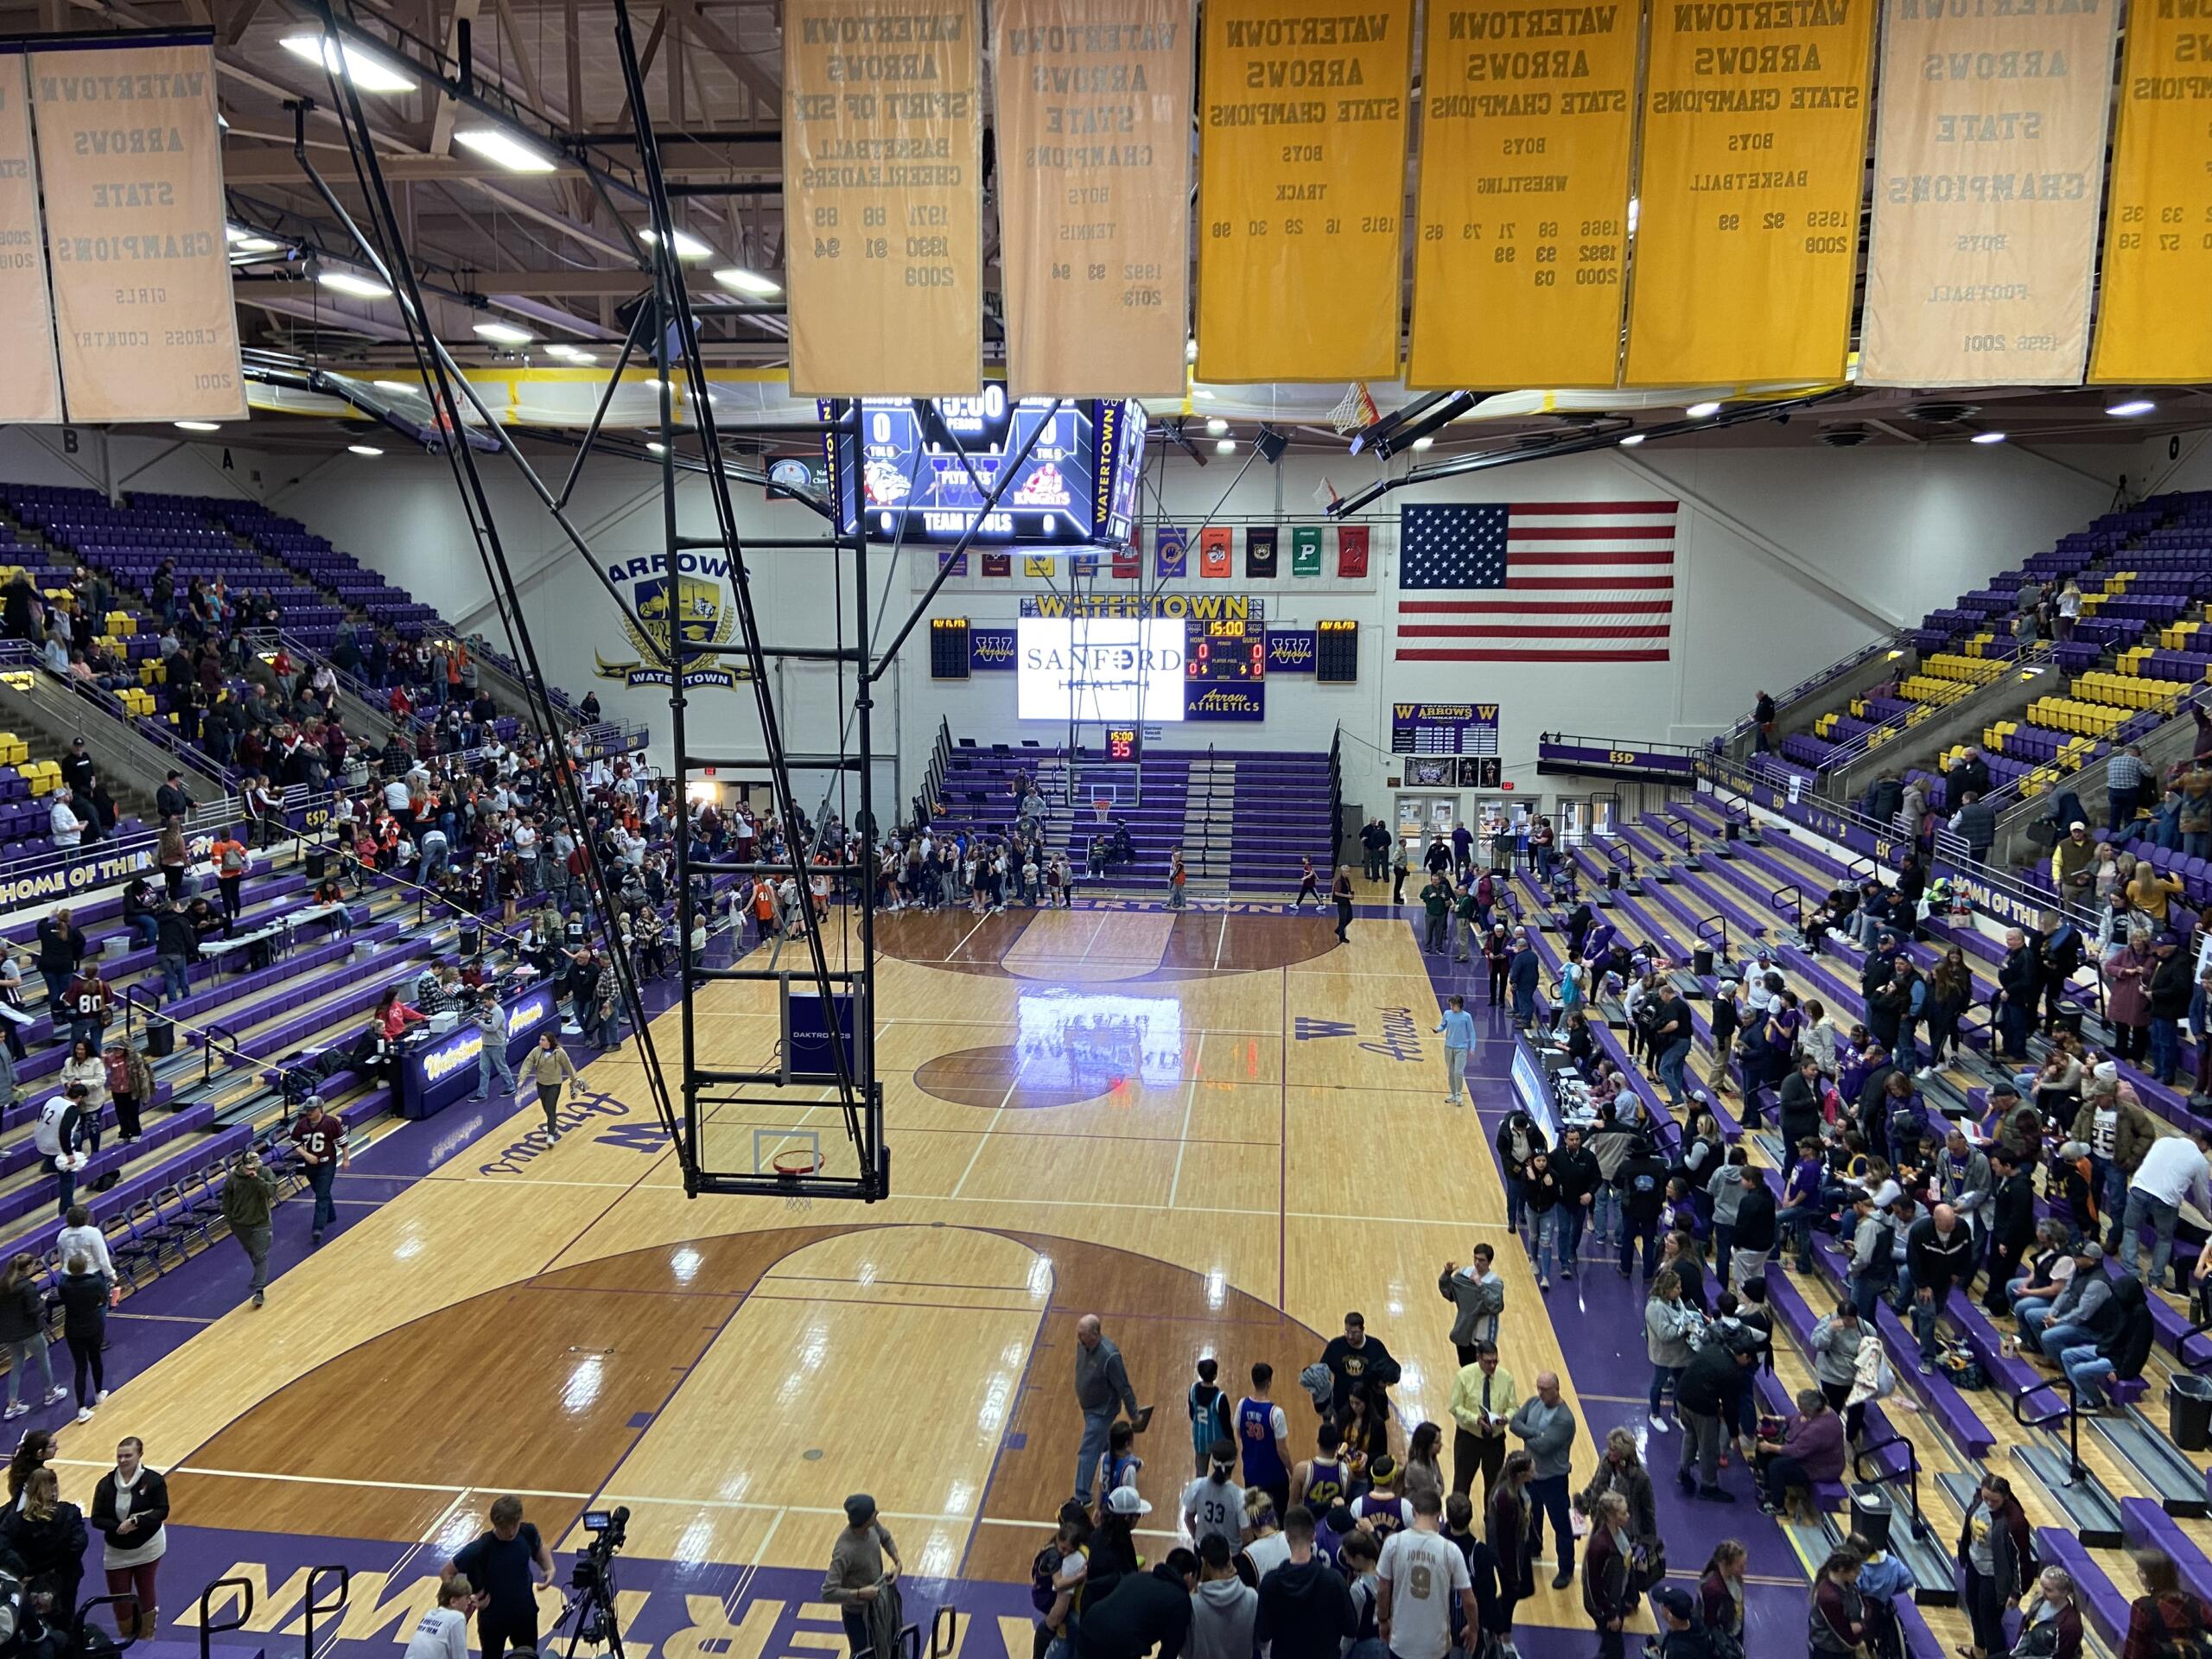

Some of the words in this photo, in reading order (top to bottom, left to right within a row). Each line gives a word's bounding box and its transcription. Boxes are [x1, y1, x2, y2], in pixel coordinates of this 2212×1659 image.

[873, 412, 891, 443] 0
[63, 429, 79, 454] B
[222, 448, 234, 470] A
[1096, 410, 1115, 523] WATERTOWN
[1014, 492, 1071, 505] KNIGHTS
[880, 512, 892, 529] 0
[923, 513, 964, 531] TEAM
[1043, 514, 1054, 531] 0
[1298, 544, 1315, 560] P
[1036, 594, 1249, 620] WATERTOWN
[1210, 620, 1243, 635] 15:00
[973, 645, 1014, 657] Arrows
[976, 637, 1012, 662] W
[1198, 644, 1207, 658] 0
[1253, 644, 1262, 658] 0
[1268, 646, 1313, 658] Arrows
[1272, 639, 1310, 664] W
[1027, 648, 1181, 671] SANFORD
[1189, 663, 1197, 674] 0
[1254, 663, 1262, 674] 0
[632, 672, 728, 685] WATETOWN
[1058, 680, 1150, 690] HEALTH
[1200, 688, 1248, 702] Arrow
[1189, 702, 1259, 711] ATHLETICS
[1395, 705, 1414, 719] W
[1418, 708, 1472, 718] ARROWS
[1477, 706, 1497, 720] W
[1110, 732, 1133, 741] 15:00
[1112, 741, 1130, 757] 35
[1610, 751, 1635, 764] ESD
[1731, 775, 1753, 795] ARROWS
[1773, 794, 1784, 809] ESD
[306, 810, 328, 825] ESD
[0, 870, 66, 905] HOME
[69, 864, 97, 887] OF
[759, 892, 768, 901] 41
[1953, 874, 1990, 908] HOME
[1992, 893, 2010, 916] OF
[2011, 900, 2039, 931] THE
[79, 995, 101, 1013] 80
[1295, 1017, 1357, 1040] W
[1358, 1006, 1424, 1061] Arrows
[302, 1132, 325, 1154] 76
[1197, 1406, 1208, 1424] 2
[1309, 1480, 1339, 1502] 42
[1205, 1501, 1224, 1524] 33
[1407, 1549, 1436, 1564] JORDAN
[1410, 1565, 1431, 1600] 9
